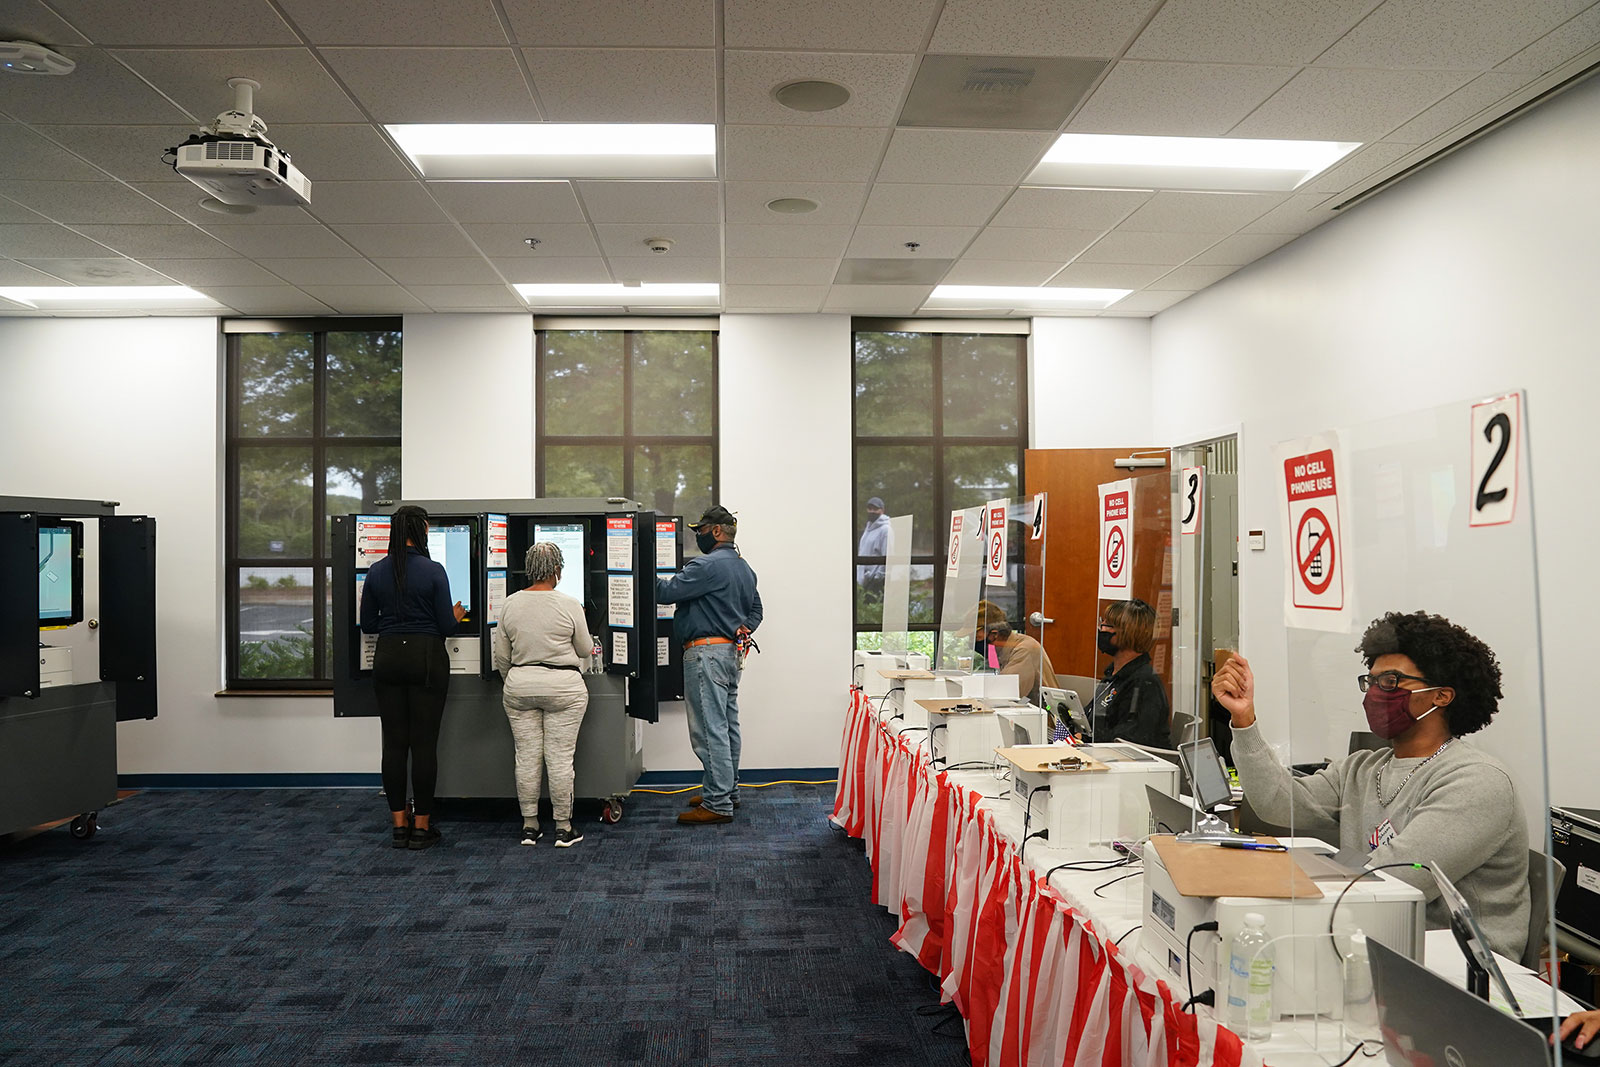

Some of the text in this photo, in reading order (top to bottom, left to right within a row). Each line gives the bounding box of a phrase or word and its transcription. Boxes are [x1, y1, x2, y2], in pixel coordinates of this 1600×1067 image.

[1294, 460, 1327, 478] NO CELL
[1476, 412, 1511, 512] 2
[1291, 476, 1333, 495] PHONE USE
[1109, 497, 1125, 507] NO CELL
[1181, 473, 1199, 525] 3
[1106, 507, 1127, 518] PHONE USE
